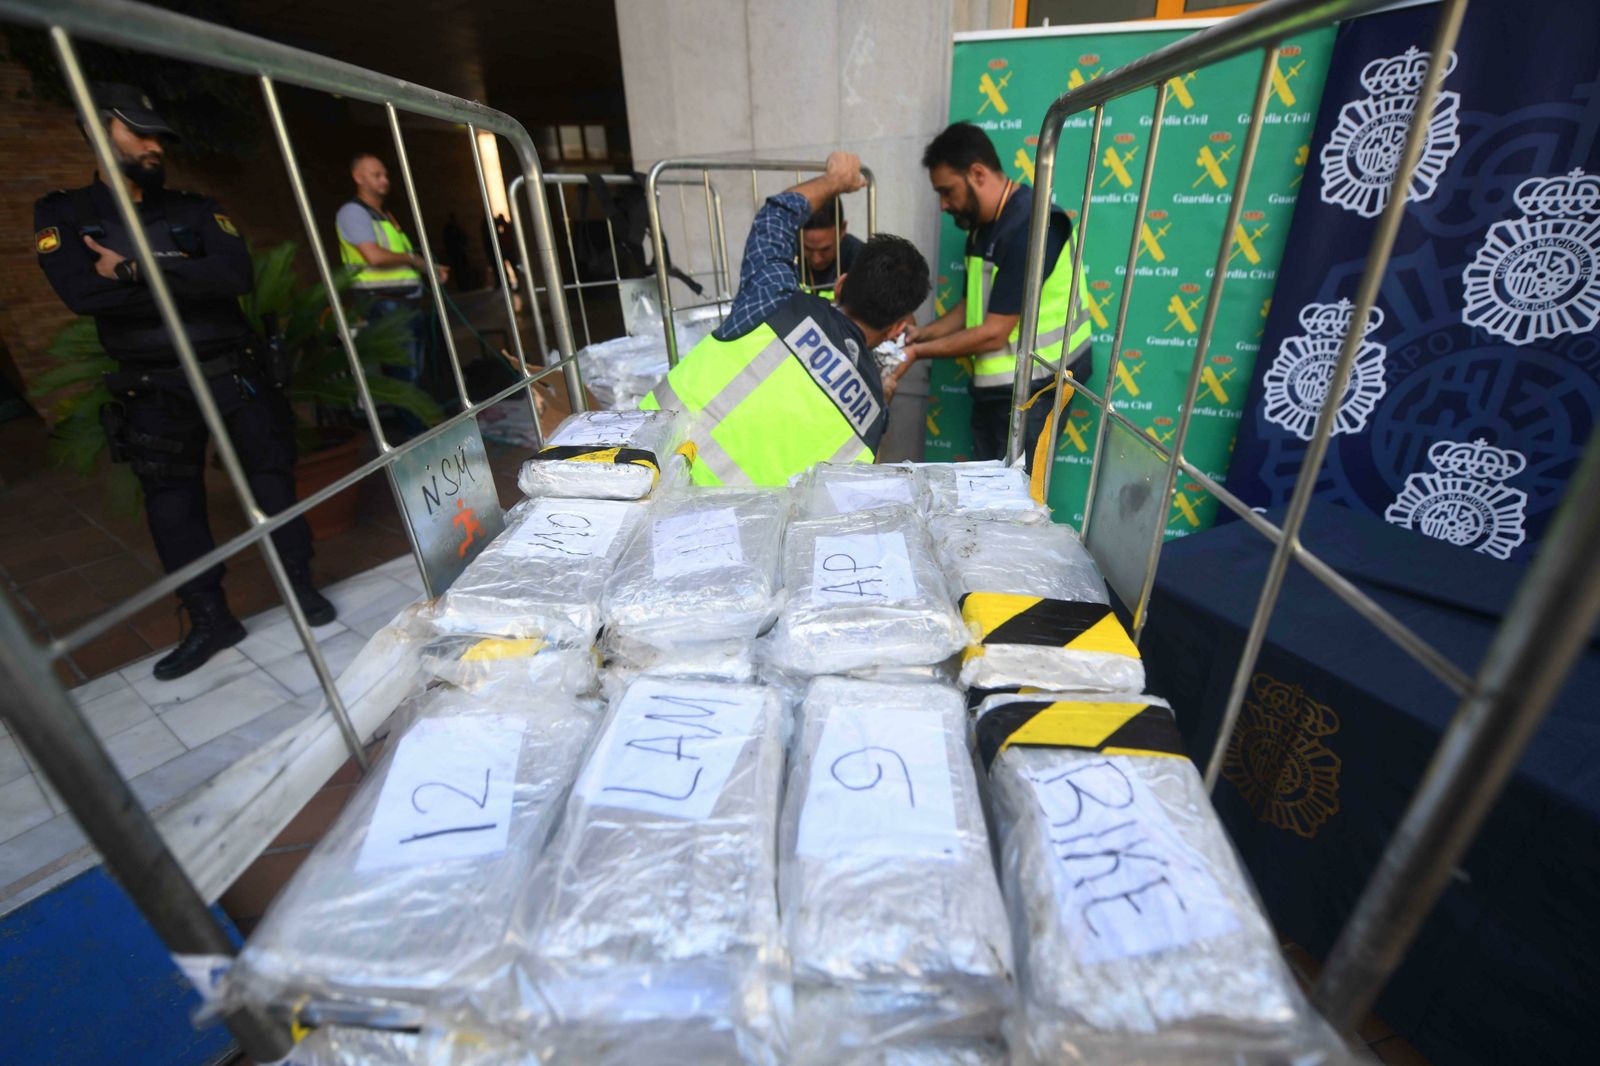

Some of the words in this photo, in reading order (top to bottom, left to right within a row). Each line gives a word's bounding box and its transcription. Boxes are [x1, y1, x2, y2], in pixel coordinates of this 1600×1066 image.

[1000, 119, 1022, 129] Civil
[1139, 115, 1181, 126] Gurdia
[1183, 114, 1209, 126] Civil
[1237, 113, 1281, 124] Gurdia
[1284, 112, 1311, 124] Civil
[1172, 193, 1214, 204] Guardia
[1268, 193, 1297, 204] Guar
[1494, 243, 1533, 280] CUERPO
[1115, 265, 1153, 276] Gurdia
[1155, 266, 1179, 277] Civil
[1250, 269, 1276, 280] Civil
[1508, 298, 1558, 311] POLICIA
[1146, 335, 1185, 347] Guardia
[795, 327, 873, 427] POLICIA
[1131, 400, 1153, 411] Civil
[421, 447, 477, 515] NSM
[820, 553, 889, 598] AP
[602, 694, 741, 801] LAM
[399, 767, 498, 845] 12
[1032, 760, 1188, 938] BIKE
